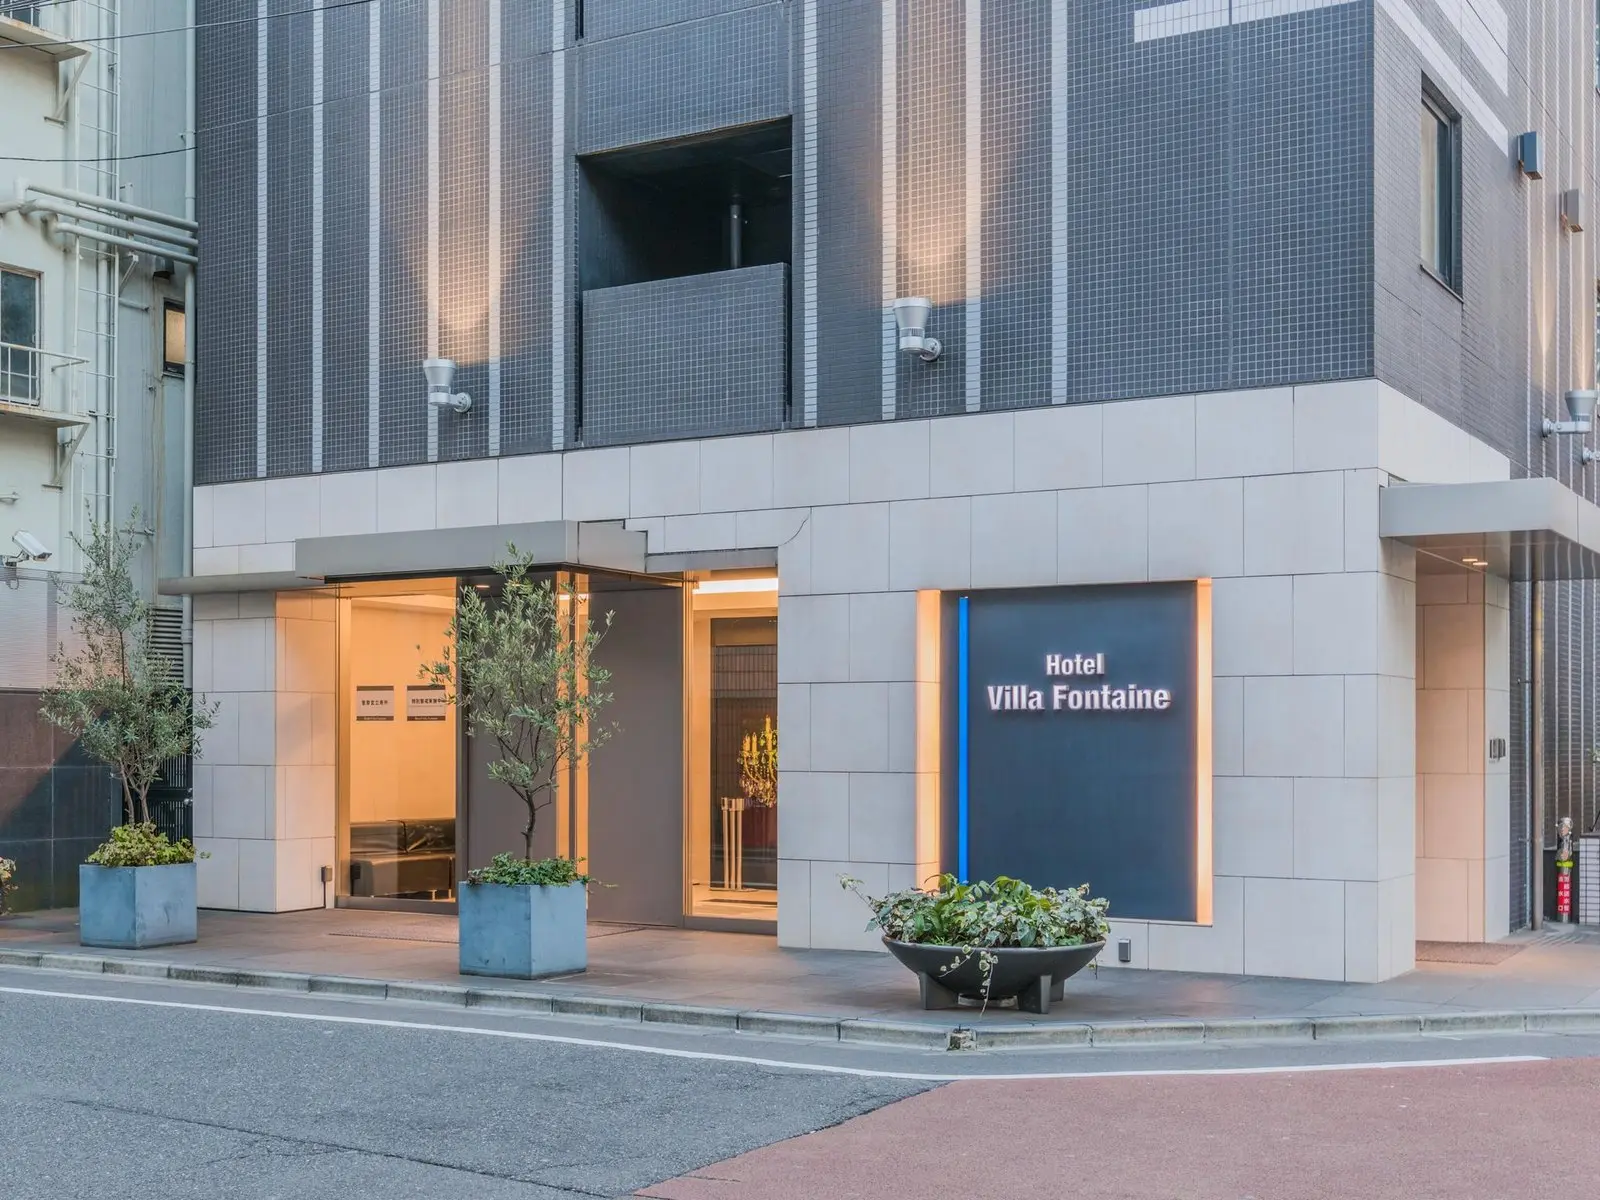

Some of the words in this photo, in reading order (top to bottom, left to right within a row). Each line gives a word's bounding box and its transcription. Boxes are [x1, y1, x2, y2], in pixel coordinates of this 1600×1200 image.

[1046, 653, 1105, 676] Hotel
[987, 685, 1045, 711] Villa
[1052, 684, 1172, 711] Fontaine
